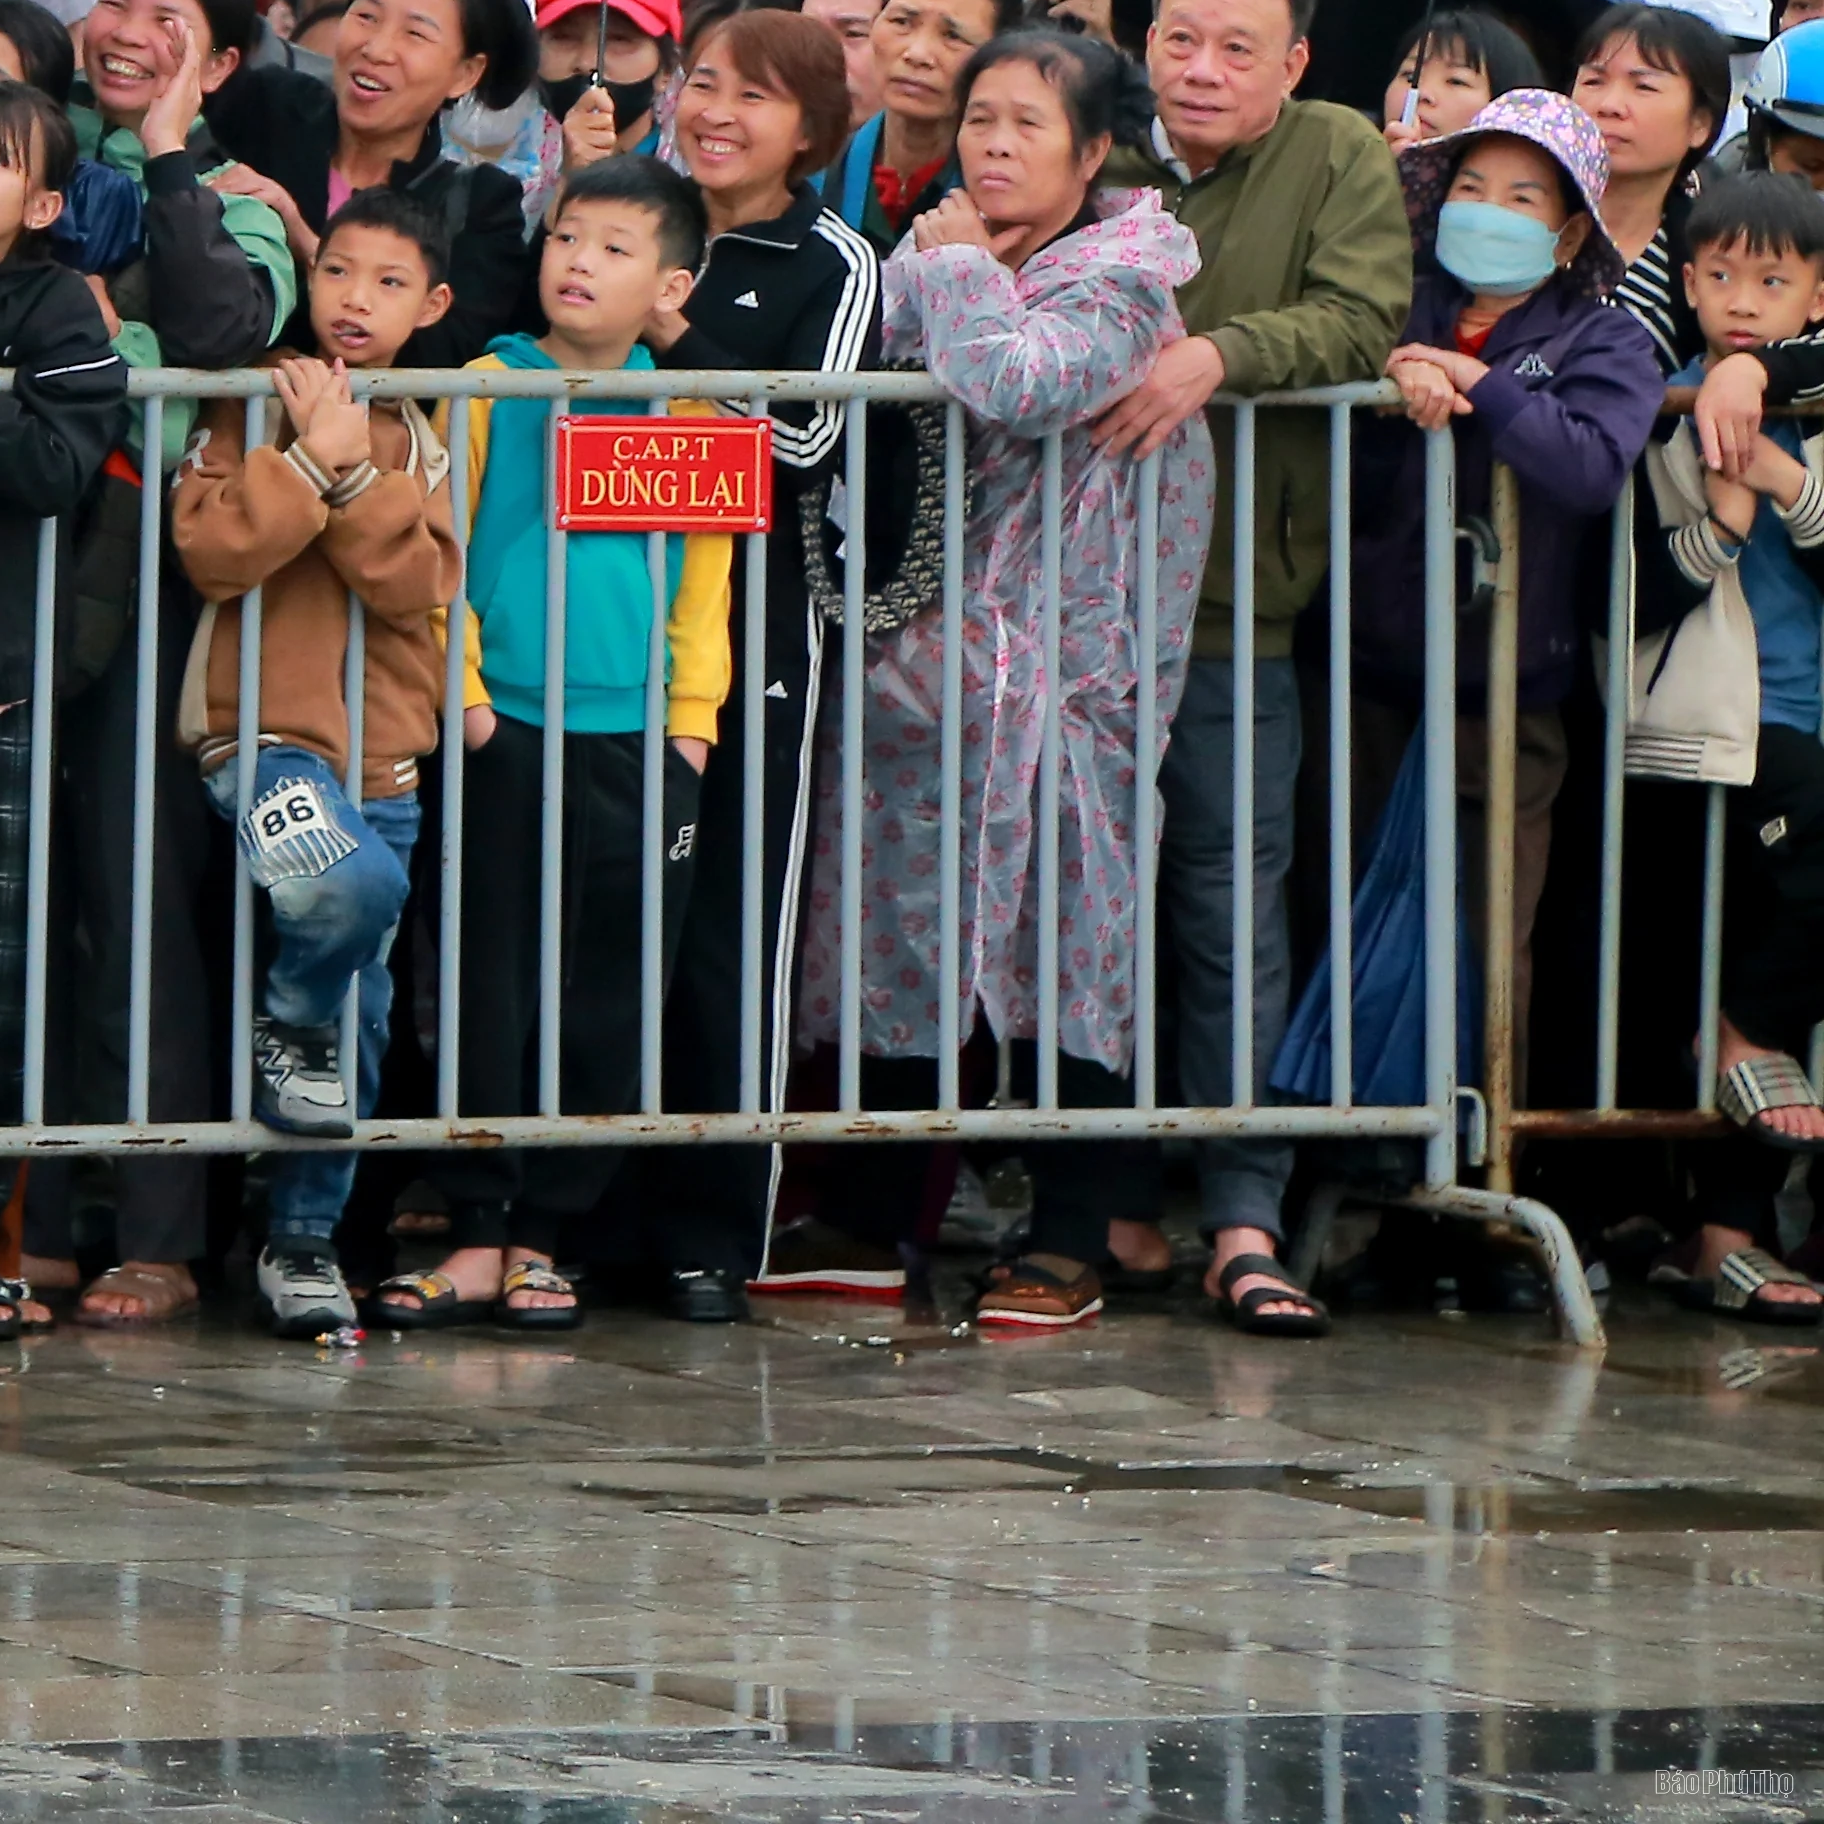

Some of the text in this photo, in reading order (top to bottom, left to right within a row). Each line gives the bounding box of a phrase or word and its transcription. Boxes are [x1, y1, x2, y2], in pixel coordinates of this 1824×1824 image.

[613, 436, 714, 461] C.A.P.T
[687, 471, 746, 516] LẠI
[262, 795, 315, 837] 86
